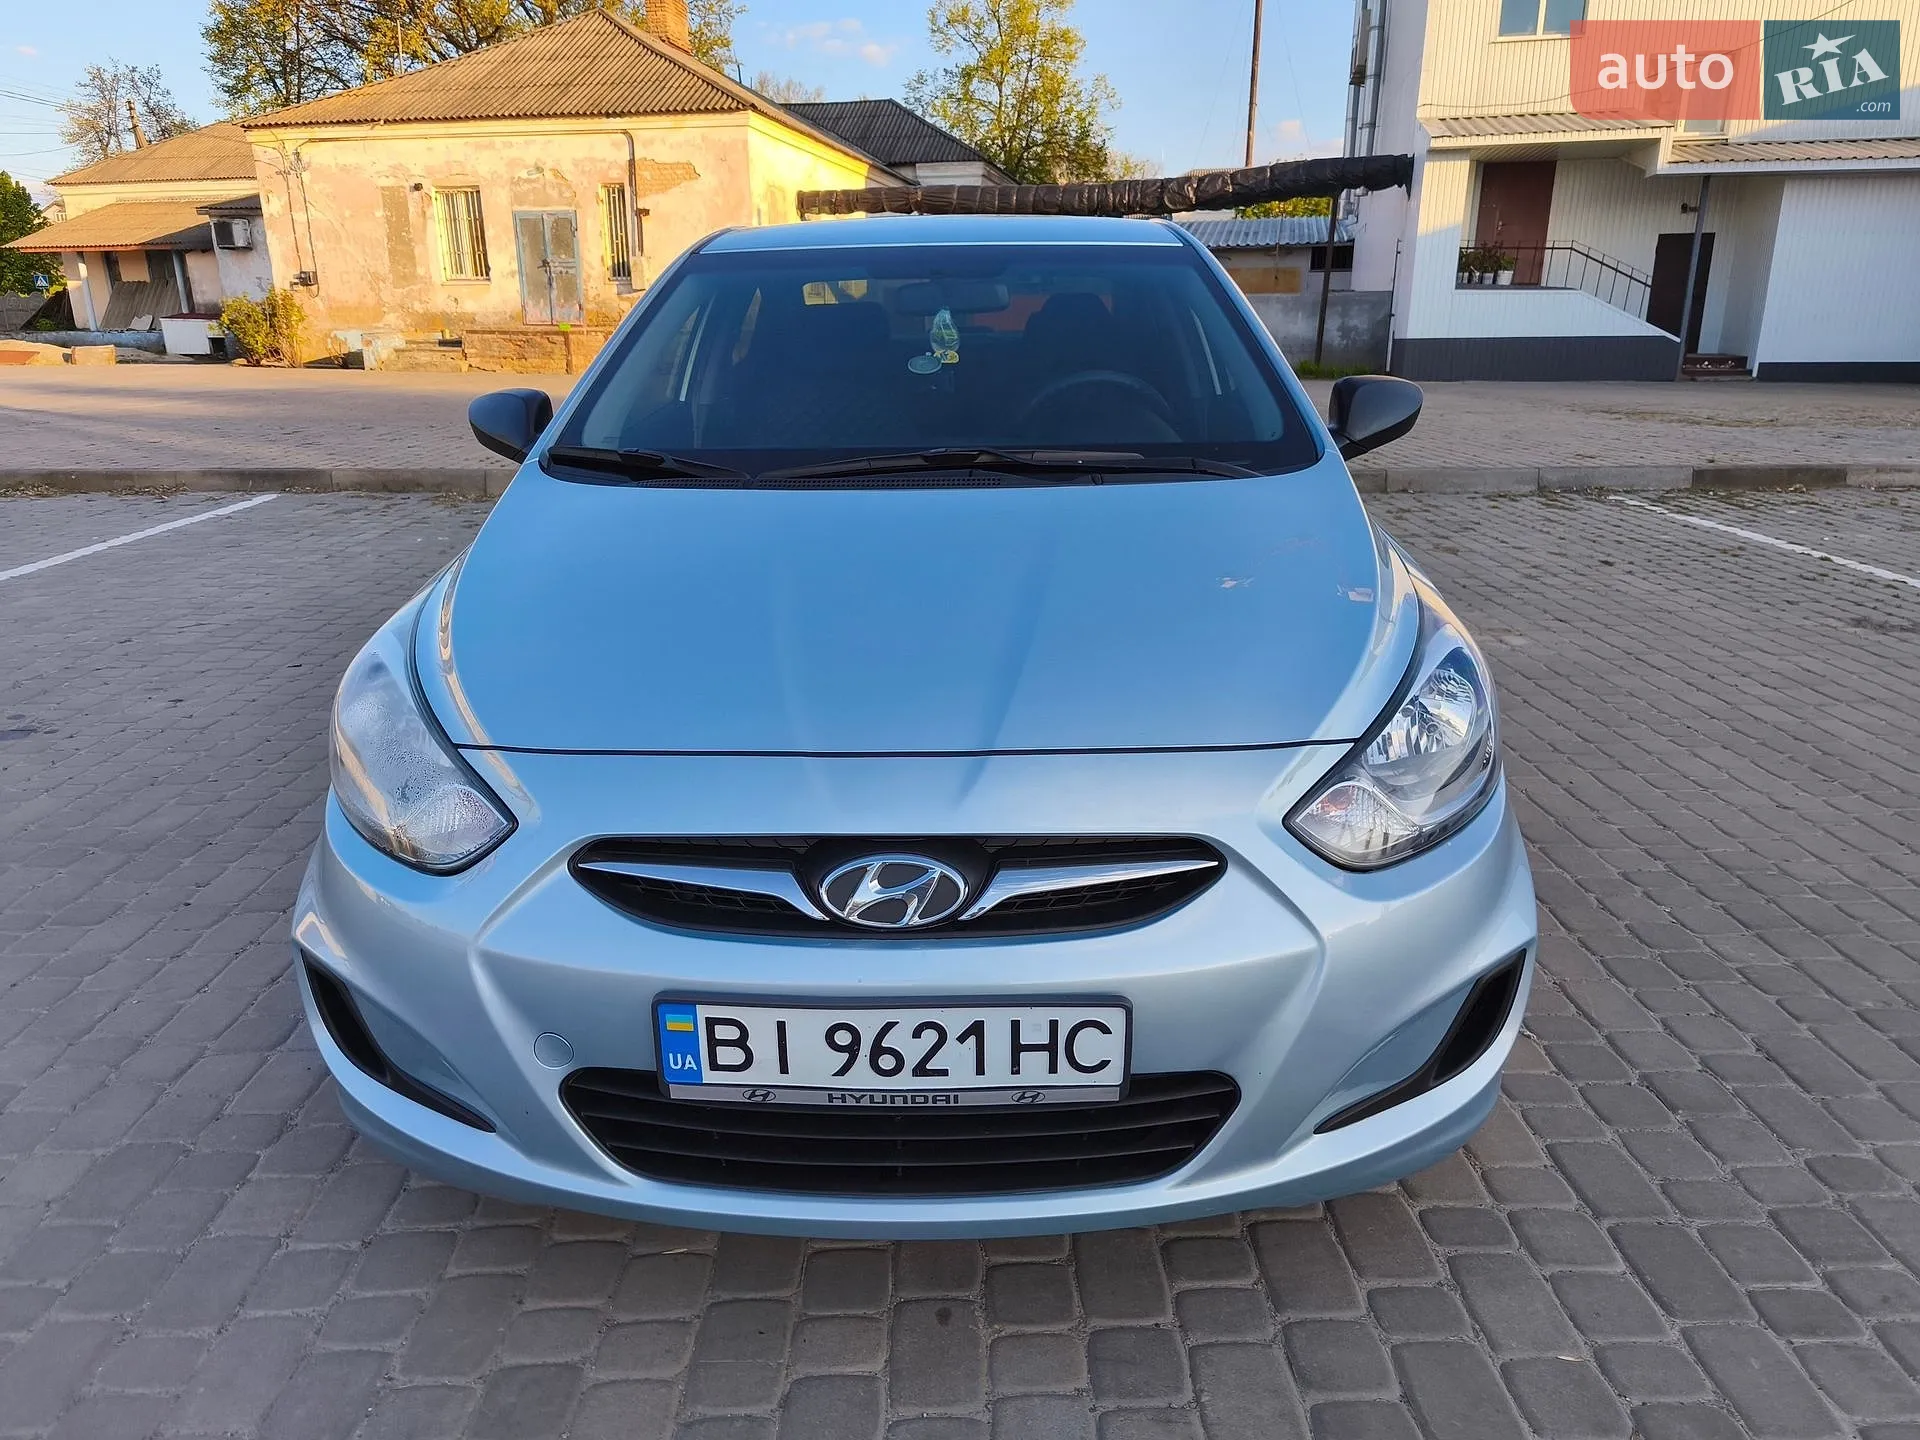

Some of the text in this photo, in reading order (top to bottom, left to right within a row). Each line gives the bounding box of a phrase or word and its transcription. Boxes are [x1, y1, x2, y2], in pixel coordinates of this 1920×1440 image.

[705, 1016, 1113, 1078] BI 9621 HC
[668, 1052, 698, 1071] UA
[827, 1091, 959, 1105] HYUNDAI
